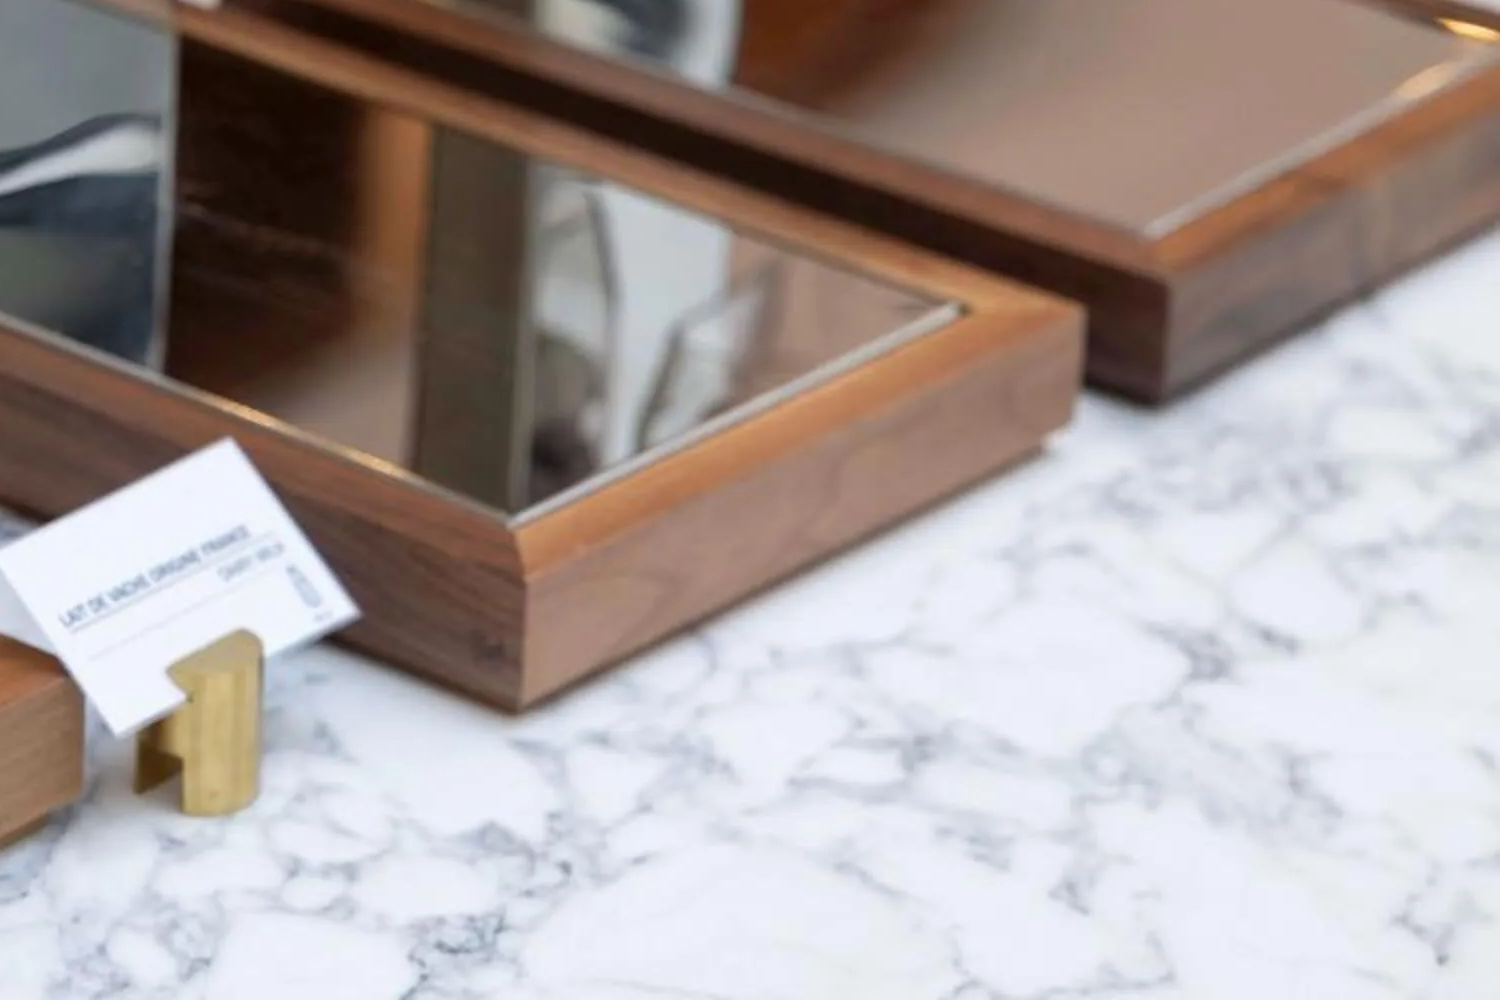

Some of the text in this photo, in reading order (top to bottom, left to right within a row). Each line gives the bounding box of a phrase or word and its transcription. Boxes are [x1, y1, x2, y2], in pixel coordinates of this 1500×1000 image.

[59, 603, 87, 628] LAIT
[87, 596, 109, 614] DE
[107, 573, 151, 602] VACHE
[149, 550, 202, 582] ORIGINE
